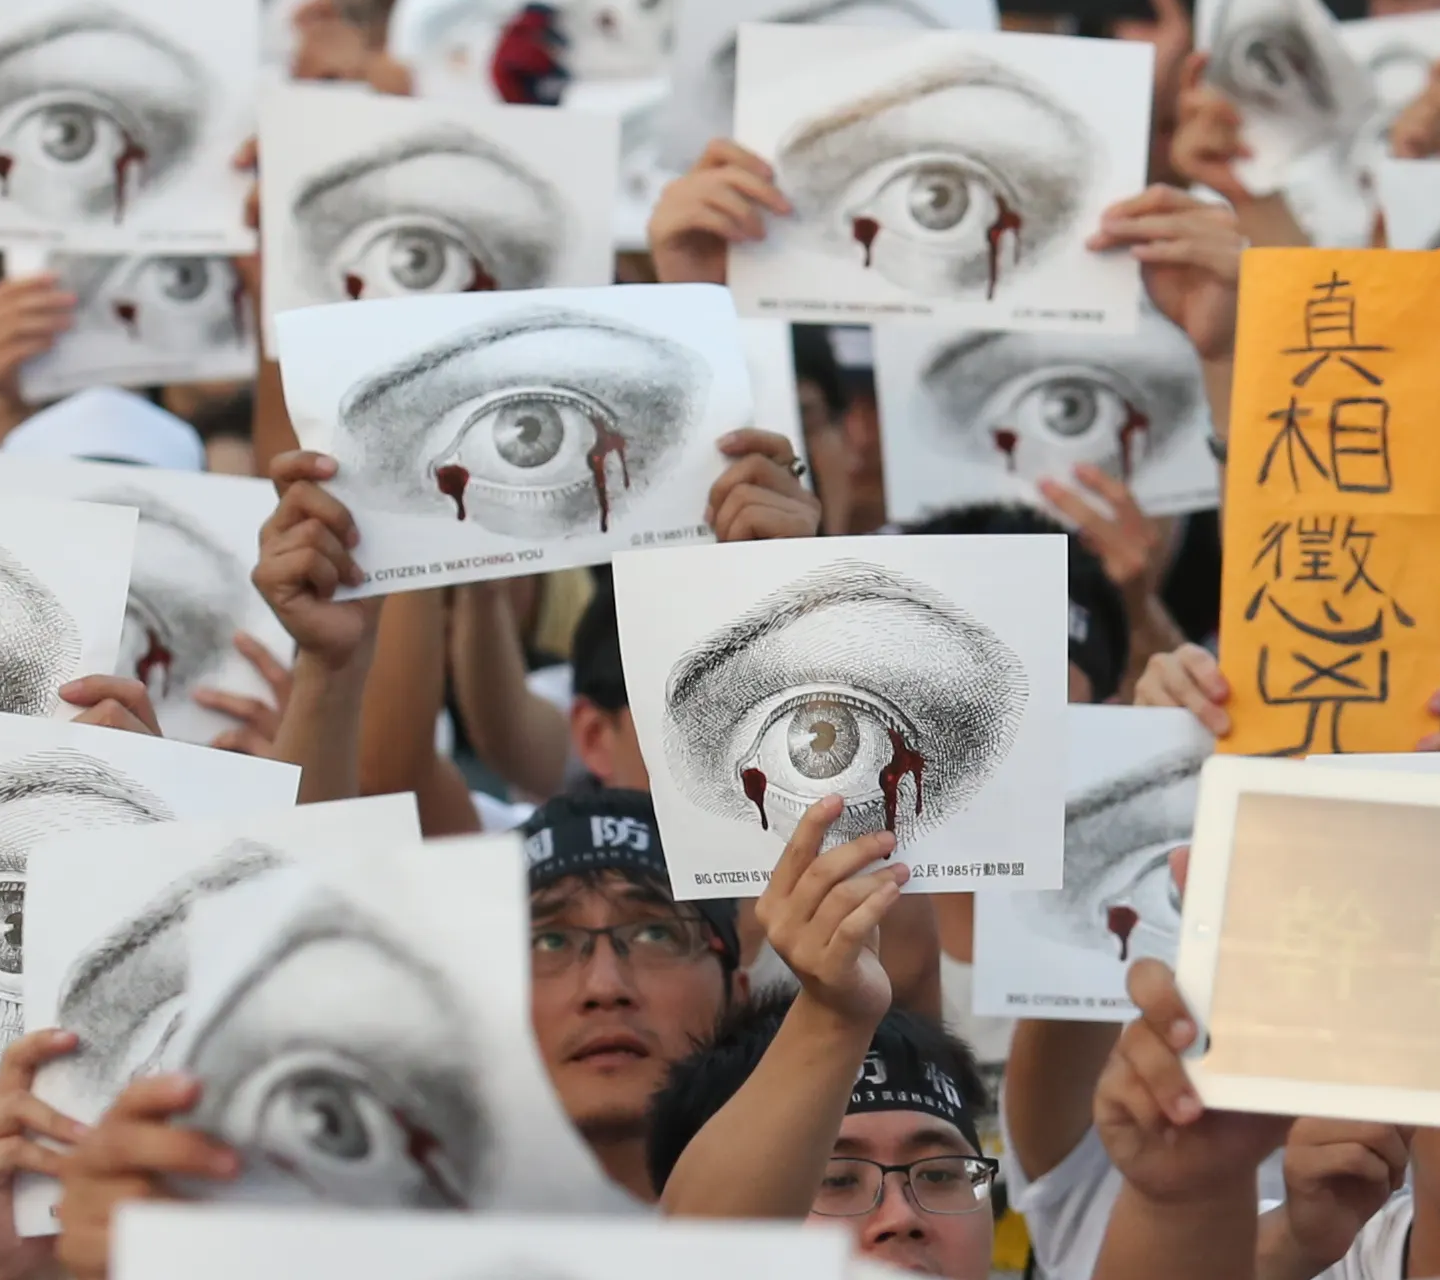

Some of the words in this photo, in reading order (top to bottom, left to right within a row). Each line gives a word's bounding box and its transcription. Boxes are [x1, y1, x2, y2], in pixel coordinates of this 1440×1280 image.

[375, 565, 426, 582] CITIZEN
[429, 561, 442, 573] IS
[444, 552, 515, 571] WATCHING
[517, 548, 544, 562] YOU
[695, 873, 712, 885] BIG
[714, 871, 749, 884] CITIZEN
[751, 870, 761, 882] IS
[911, 862, 1024, 878] 公民1985行動聯盟
